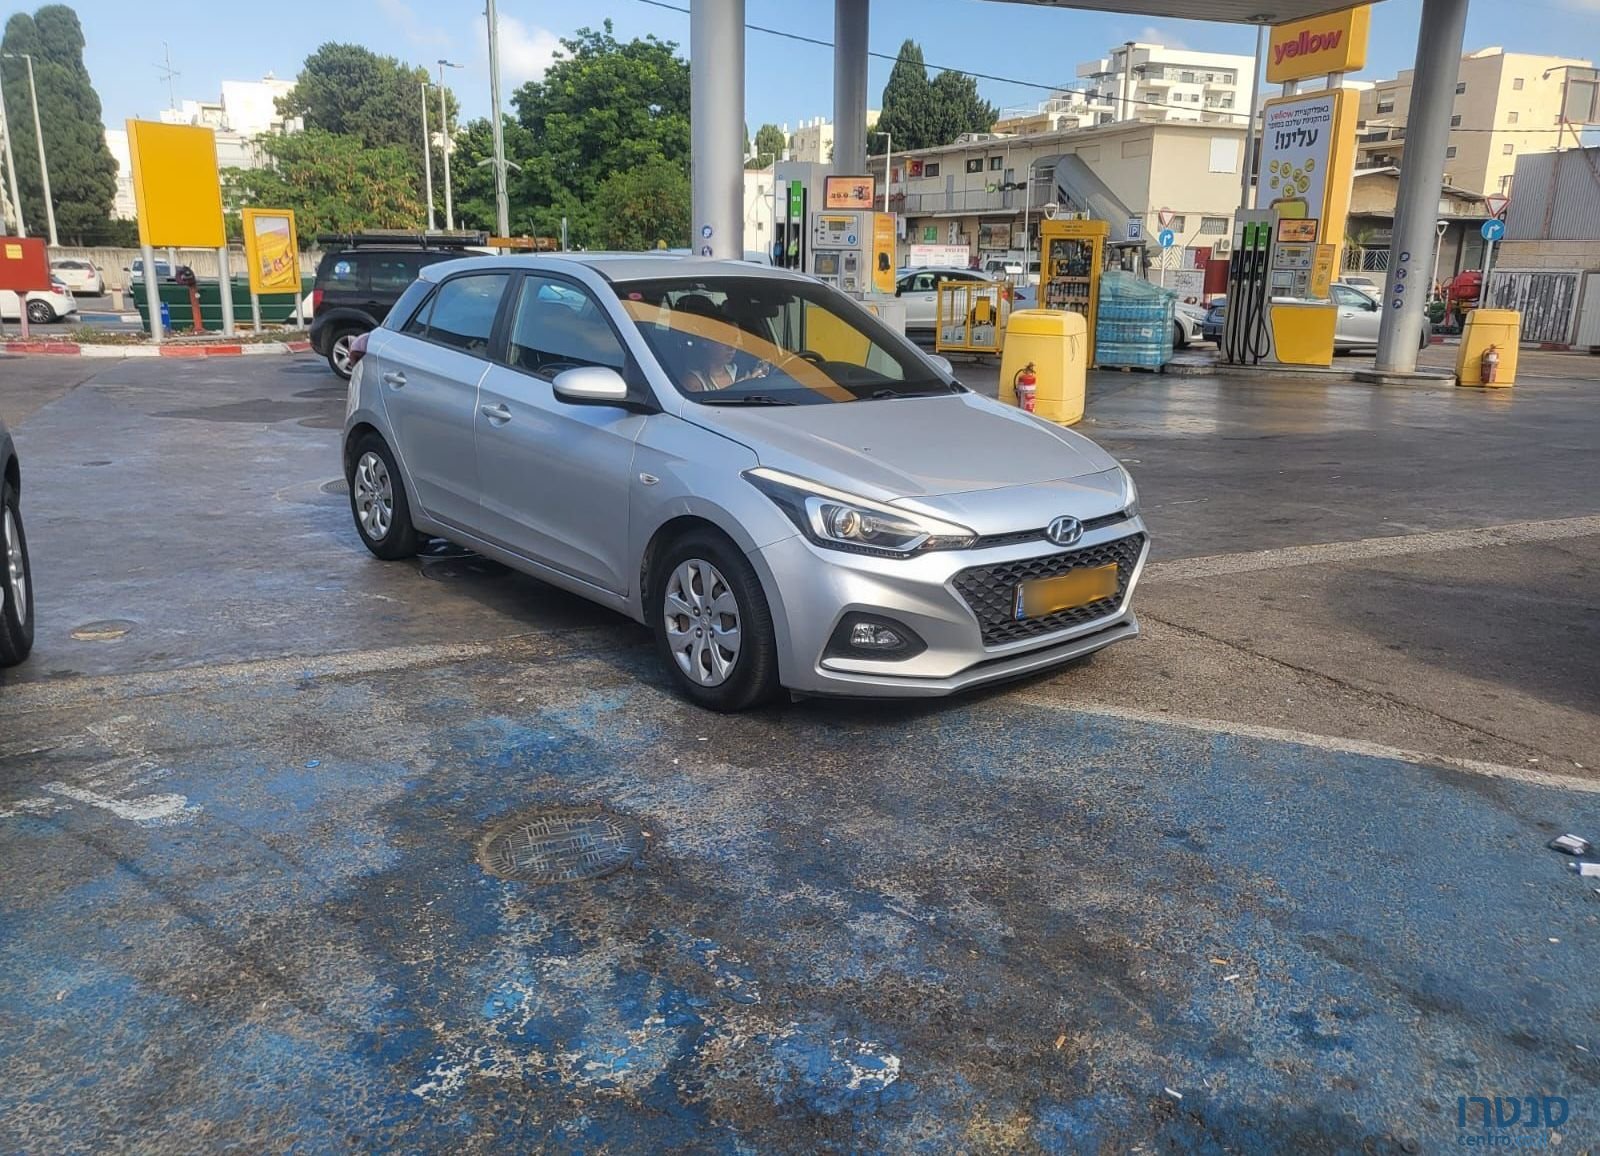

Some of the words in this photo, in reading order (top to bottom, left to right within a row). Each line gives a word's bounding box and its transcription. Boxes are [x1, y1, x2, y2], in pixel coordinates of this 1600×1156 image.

[1274, 30, 1342, 65] yellow
[1271, 110, 1294, 121] yellow
[1285, 118, 1302, 127] שלכם
[1275, 127, 1319, 150] עלינו!
